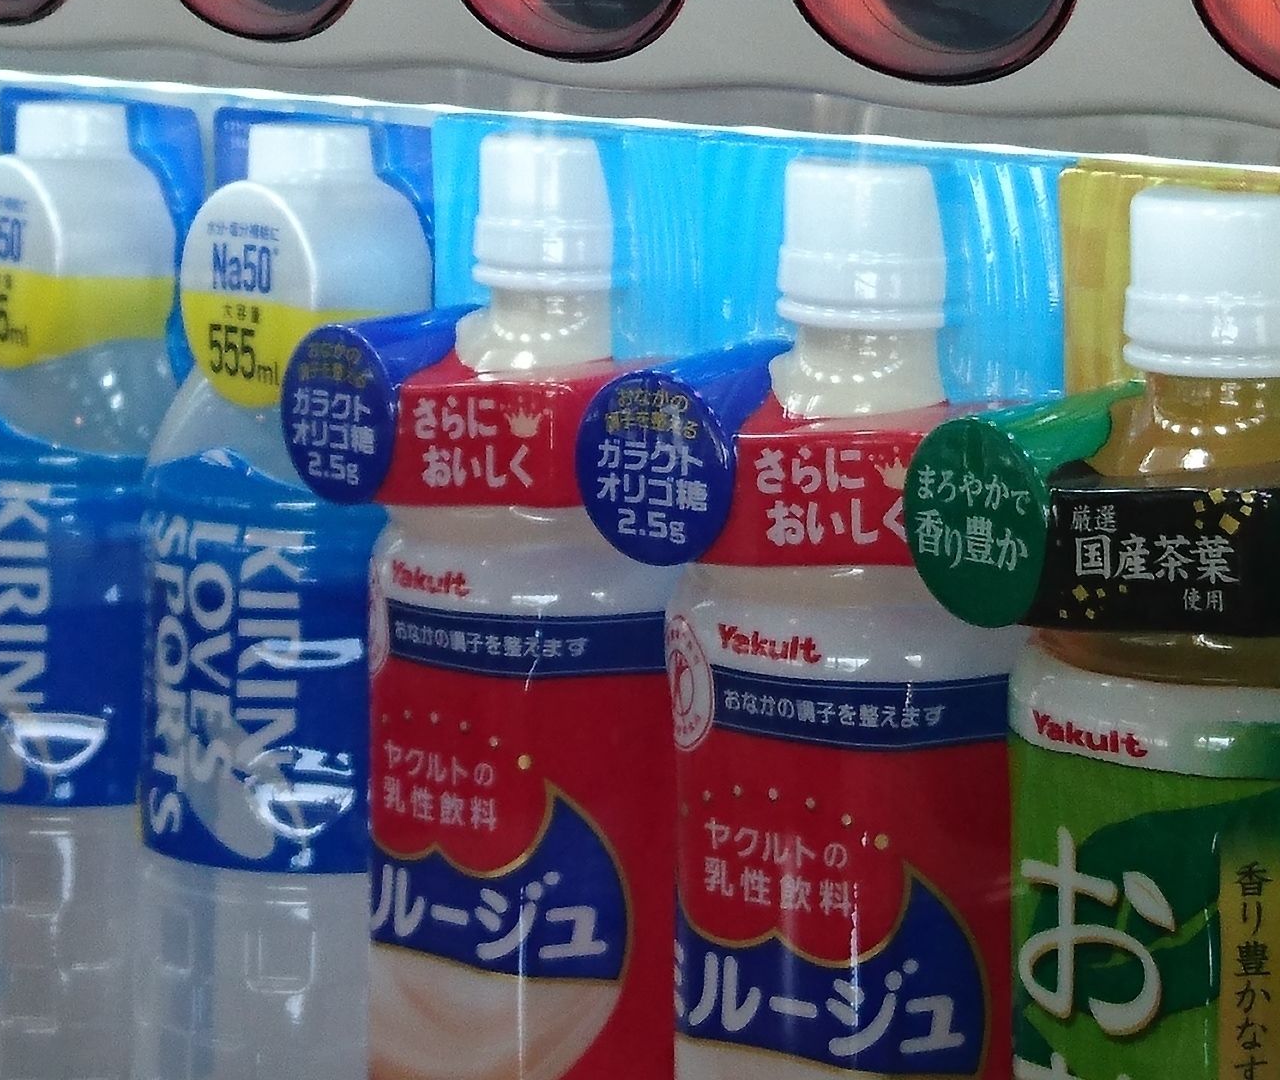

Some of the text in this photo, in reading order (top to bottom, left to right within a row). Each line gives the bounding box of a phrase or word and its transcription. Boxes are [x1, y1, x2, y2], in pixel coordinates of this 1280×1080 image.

[209, 322, 280, 386] 555ml
[292, 386, 371, 423] ガラクト
[413, 395, 500, 441] さらに
[292, 418, 375, 455] オリゴ糖
[596, 437, 704, 477] ガラクト
[307, 451, 360, 486] 2.5g
[421, 444, 535, 489] おいしく
[754, 447, 866, 495] さらに
[917, 464, 1031, 515] まろやかで
[596, 471, 708, 512] オリゴ糖
[617, 507, 687, 545] 2.5g
[765, 498, 906, 546] おいしく
[915, 508, 1029, 572] 香り豊か
[1071, 505, 1117, 534] 厳選
[390, 557, 472, 599] Yakult
[1074, 533, 1241, 586] 国産茶葉
[1182, 588, 1224, 613] 使用
[185, 518, 240, 782] LOVES
[234, 526, 307, 782] KIRIN
[393, 618, 588, 660] おなかの調子を整えます
[717, 622, 822, 666] Yakult
[723, 686, 946, 730] おなかの調子を整えます
[1032, 709, 1148, 758] Yakult
[382, 740, 497, 789] ヤクルトの
[383, 775, 499, 833] 乳性飲料
[703, 818, 850, 871] ヤクルトの
[703, 855, 855, 920] 乳性飲料
[371, 863, 608, 962] ルージュ
